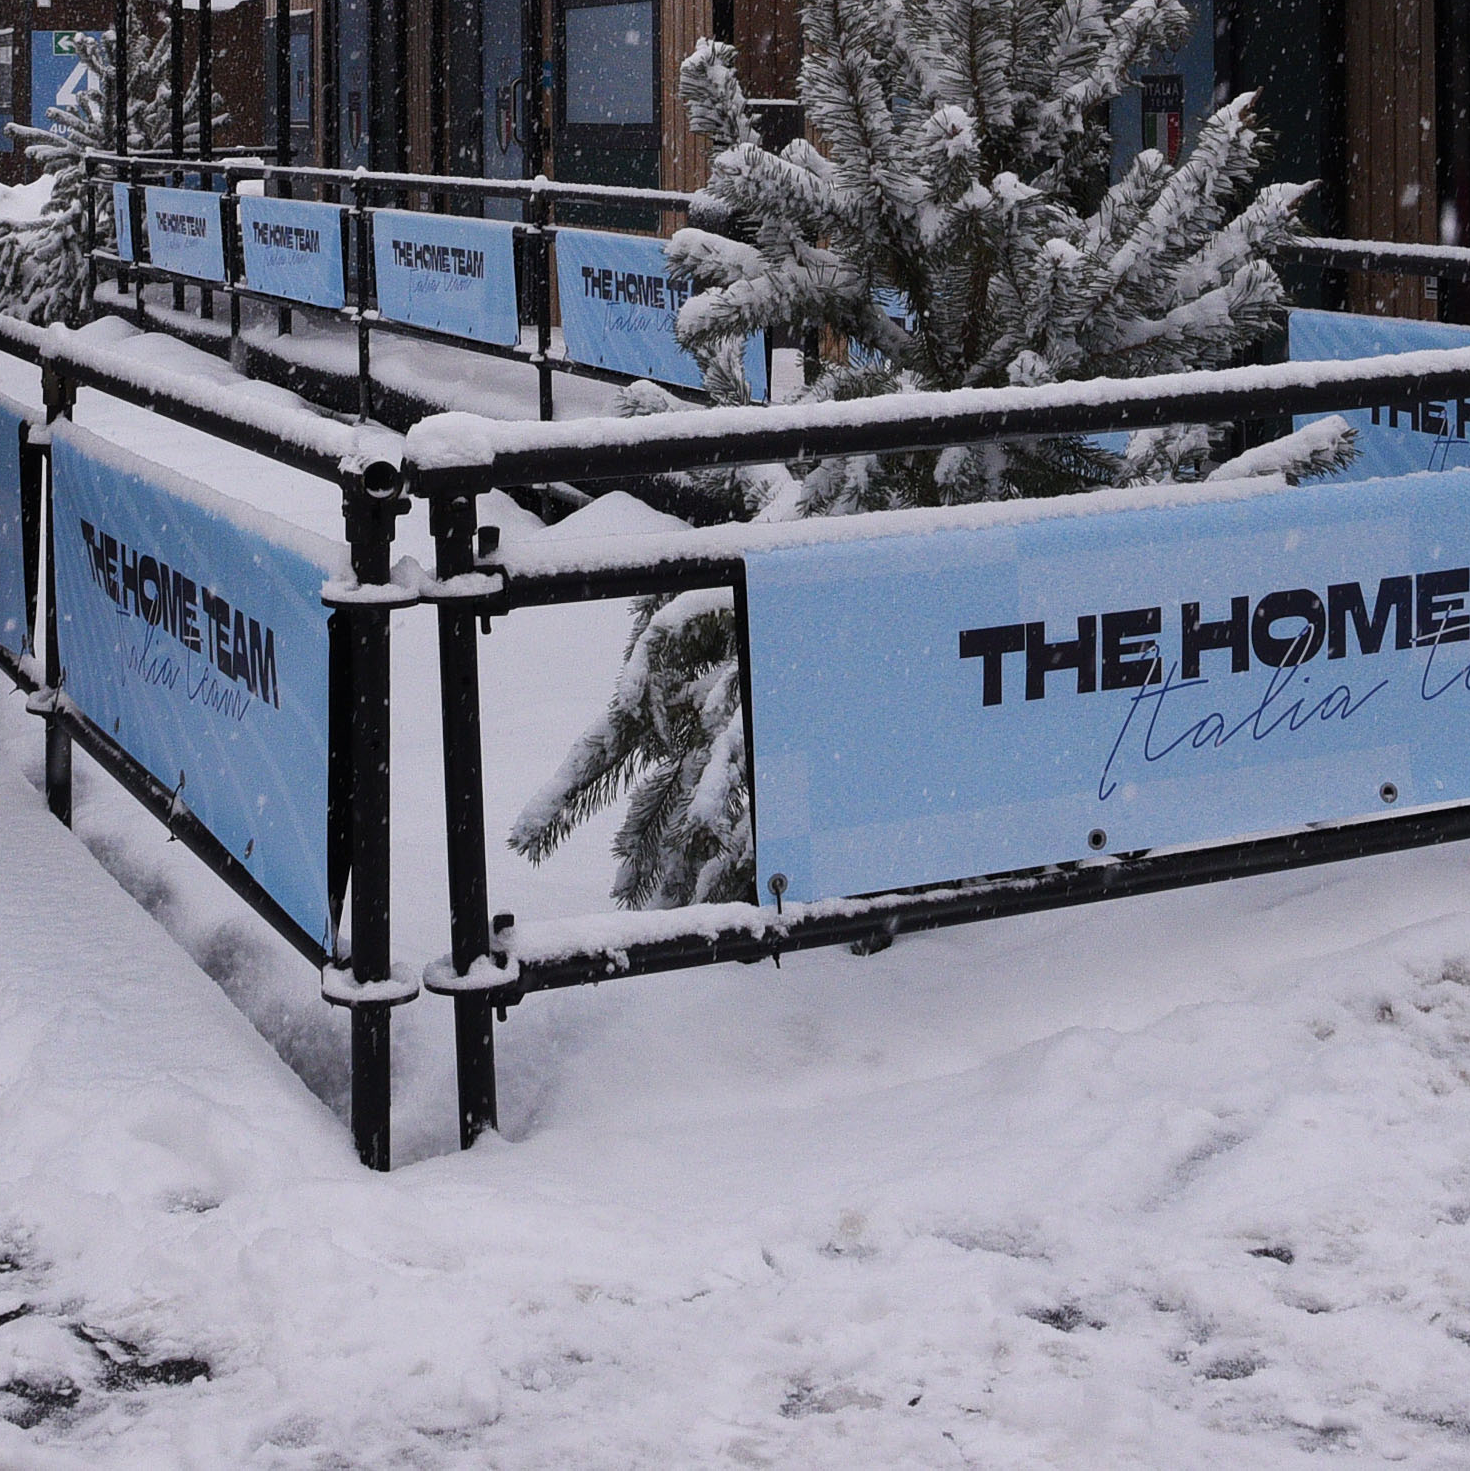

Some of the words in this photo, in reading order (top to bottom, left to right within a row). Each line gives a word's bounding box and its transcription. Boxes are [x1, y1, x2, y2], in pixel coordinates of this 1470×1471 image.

[252, 221, 269, 245] THE
[293, 228, 321, 254] TEAM
[392, 239, 413, 268] THE
[413, 242, 451, 273] HOME
[451, 247, 485, 279] TEAM
[581, 266, 613, 301] THE
[614, 271, 665, 310] HOME
[80, 518, 121, 605] THE
[120, 543, 202, 654] HOME
[201, 586, 280, 711] TEAM
[958, 606, 1163, 707] THE
[1097, 622, 1390, 800] Italia
